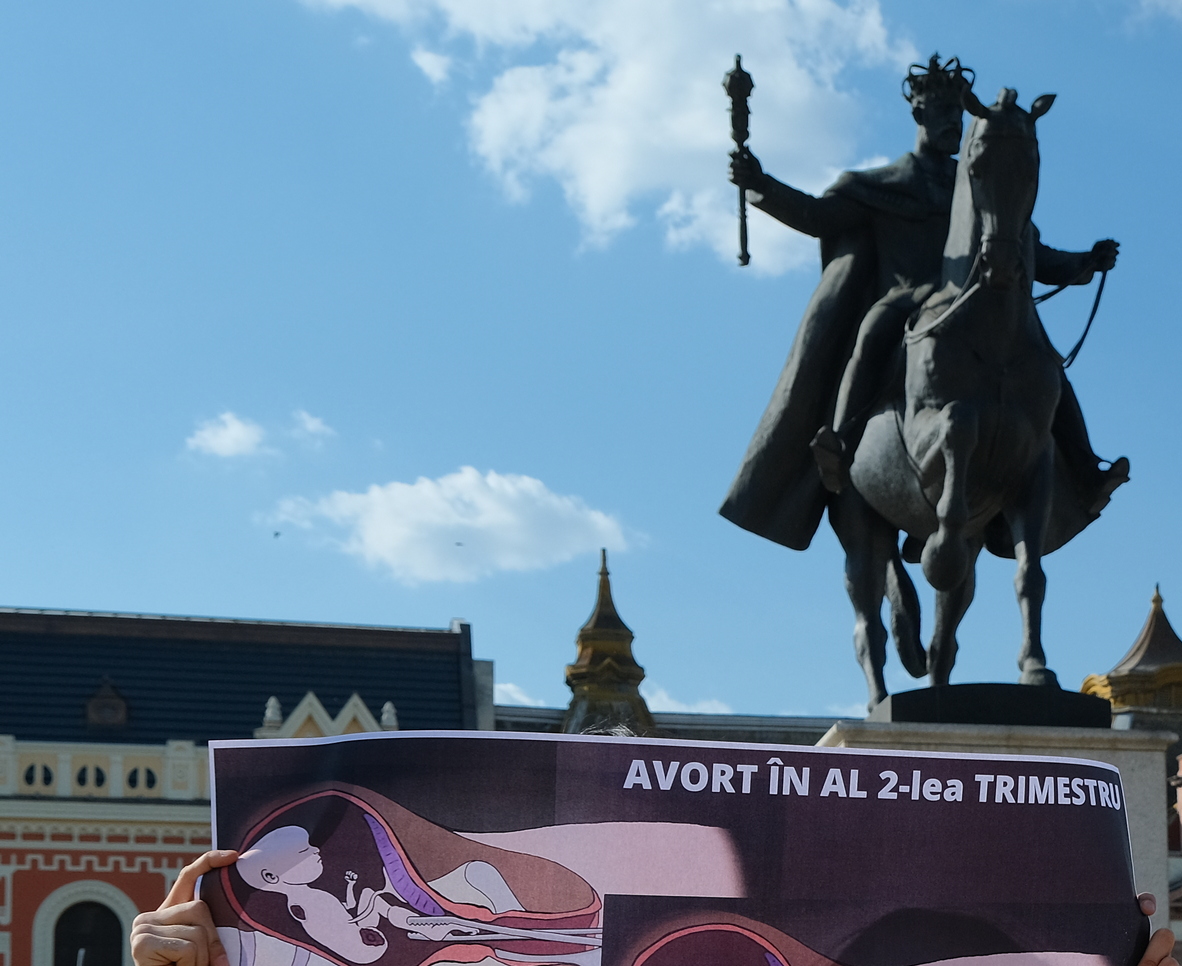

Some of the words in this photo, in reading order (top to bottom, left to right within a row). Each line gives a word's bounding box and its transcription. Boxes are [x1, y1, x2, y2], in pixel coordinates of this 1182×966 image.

[623, 759, 758, 794] AVORT
[767, 757, 810, 796] ÎN
[819, 767, 868, 799] AL
[877, 769, 964, 802] 2-lea
[974, 773, 1122, 811] TRIMESTRU
